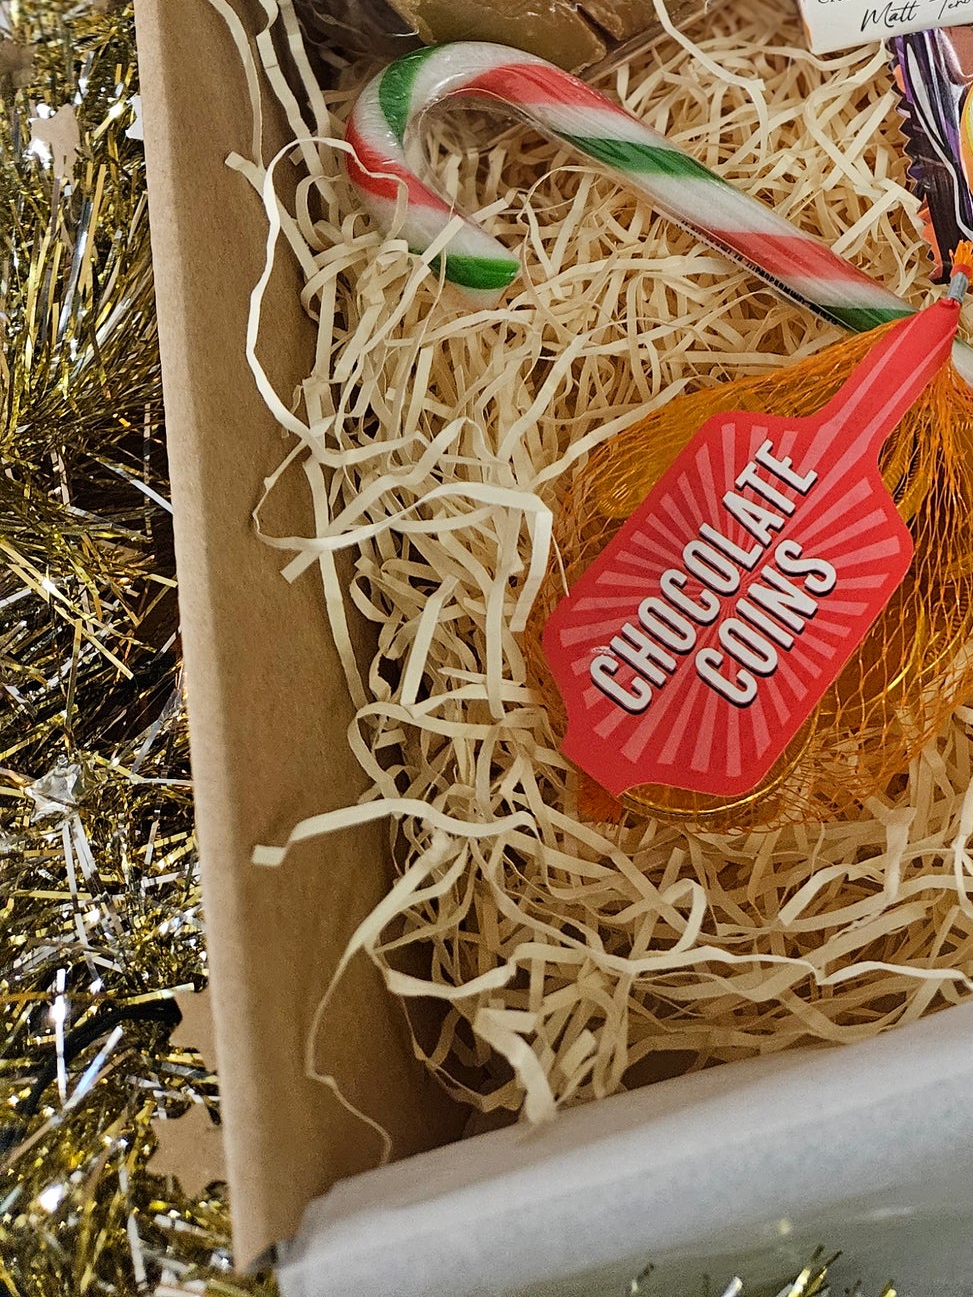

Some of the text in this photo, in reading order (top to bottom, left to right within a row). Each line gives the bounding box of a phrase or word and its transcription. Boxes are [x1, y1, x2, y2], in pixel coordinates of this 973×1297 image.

[860, 0, 921, 32] Matt
[589, 439, 818, 715] CHOCOLATE
[694, 538, 837, 708] COINS
